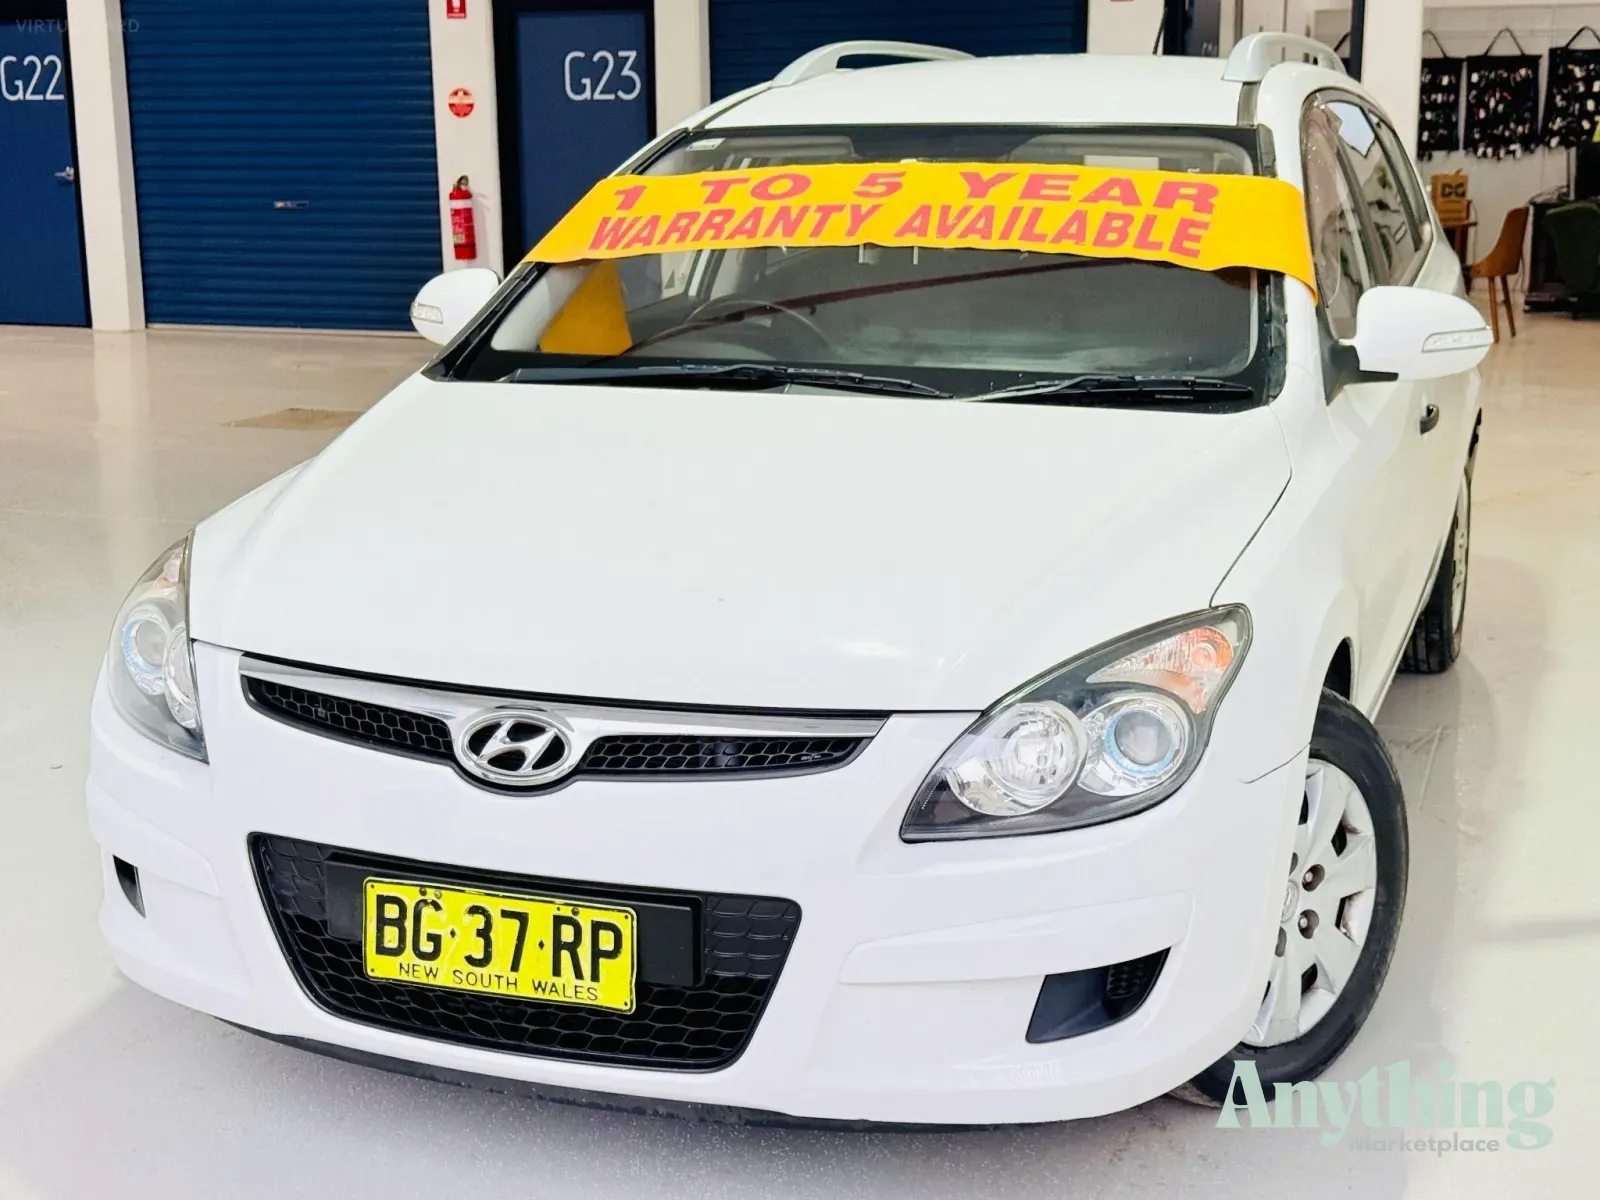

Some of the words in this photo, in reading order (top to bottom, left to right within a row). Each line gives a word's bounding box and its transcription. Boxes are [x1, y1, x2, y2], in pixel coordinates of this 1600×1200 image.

[0, 55, 65, 101] G22
[564, 50, 642, 101] G23
[614, 185, 647, 211] 1
[700, 173, 812, 205] TO
[852, 171, 907, 199] 5
[959, 171, 1220, 215] YEAR
[588, 203, 883, 251] WARRANTY
[893, 204, 1210, 259] AVAILABLE
[399, 962, 439, 979] NEW
[452, 969, 518, 992] SOUTH
[532, 979, 598, 1001] WALES
